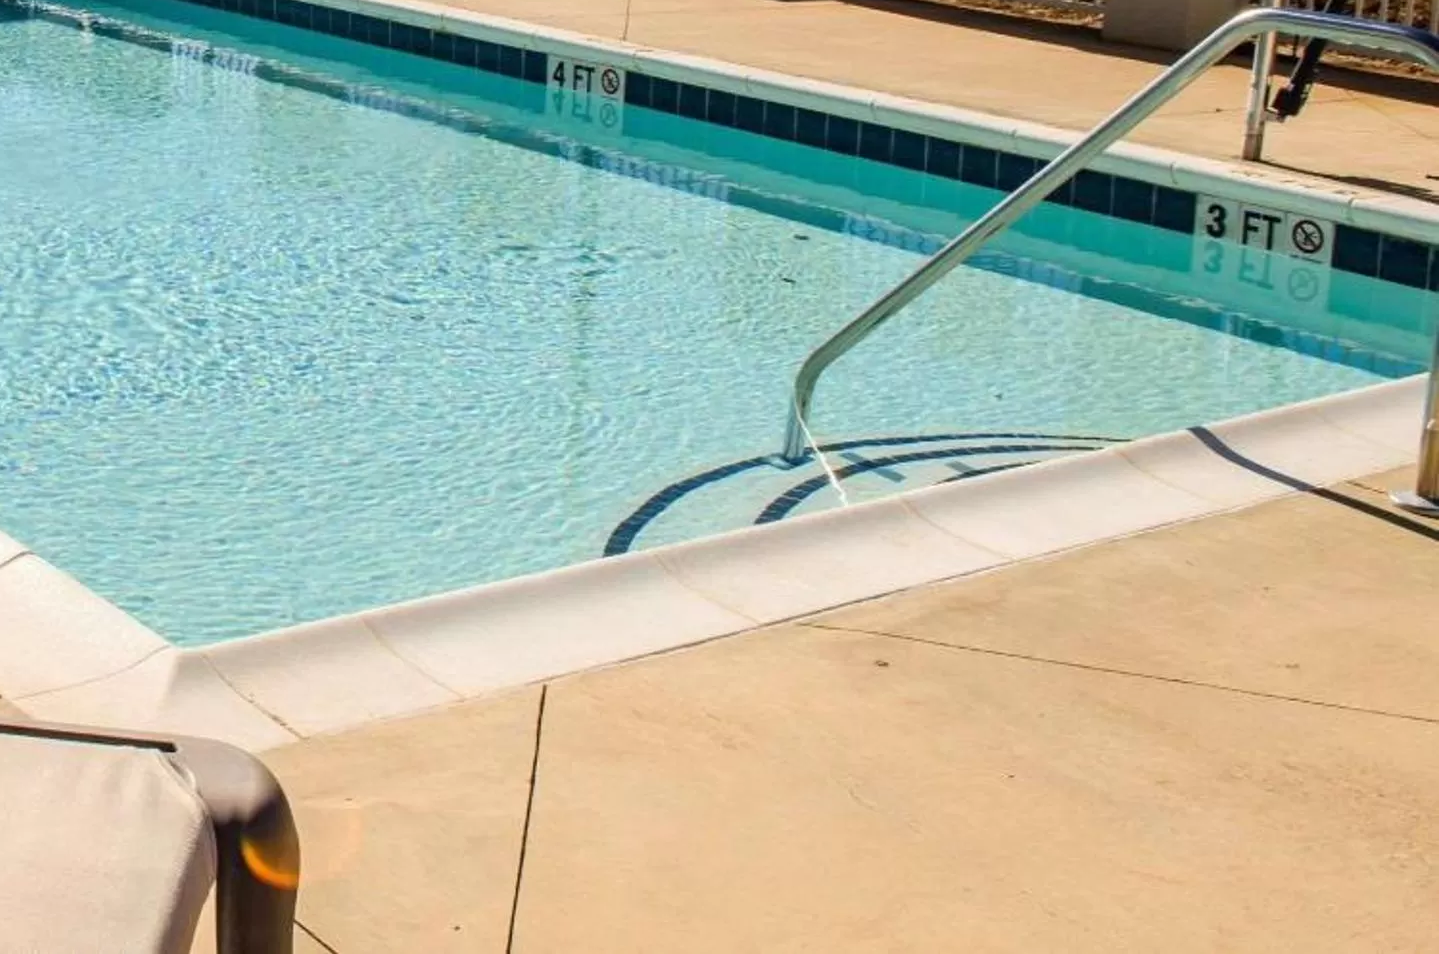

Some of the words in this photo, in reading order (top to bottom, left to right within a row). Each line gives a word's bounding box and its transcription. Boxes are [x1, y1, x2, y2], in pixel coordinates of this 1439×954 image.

[553, 61, 565, 86] 4
[573, 65, 595, 92] FT
[1206, 204, 1226, 238] 3
[1242, 210, 1281, 250] FT
